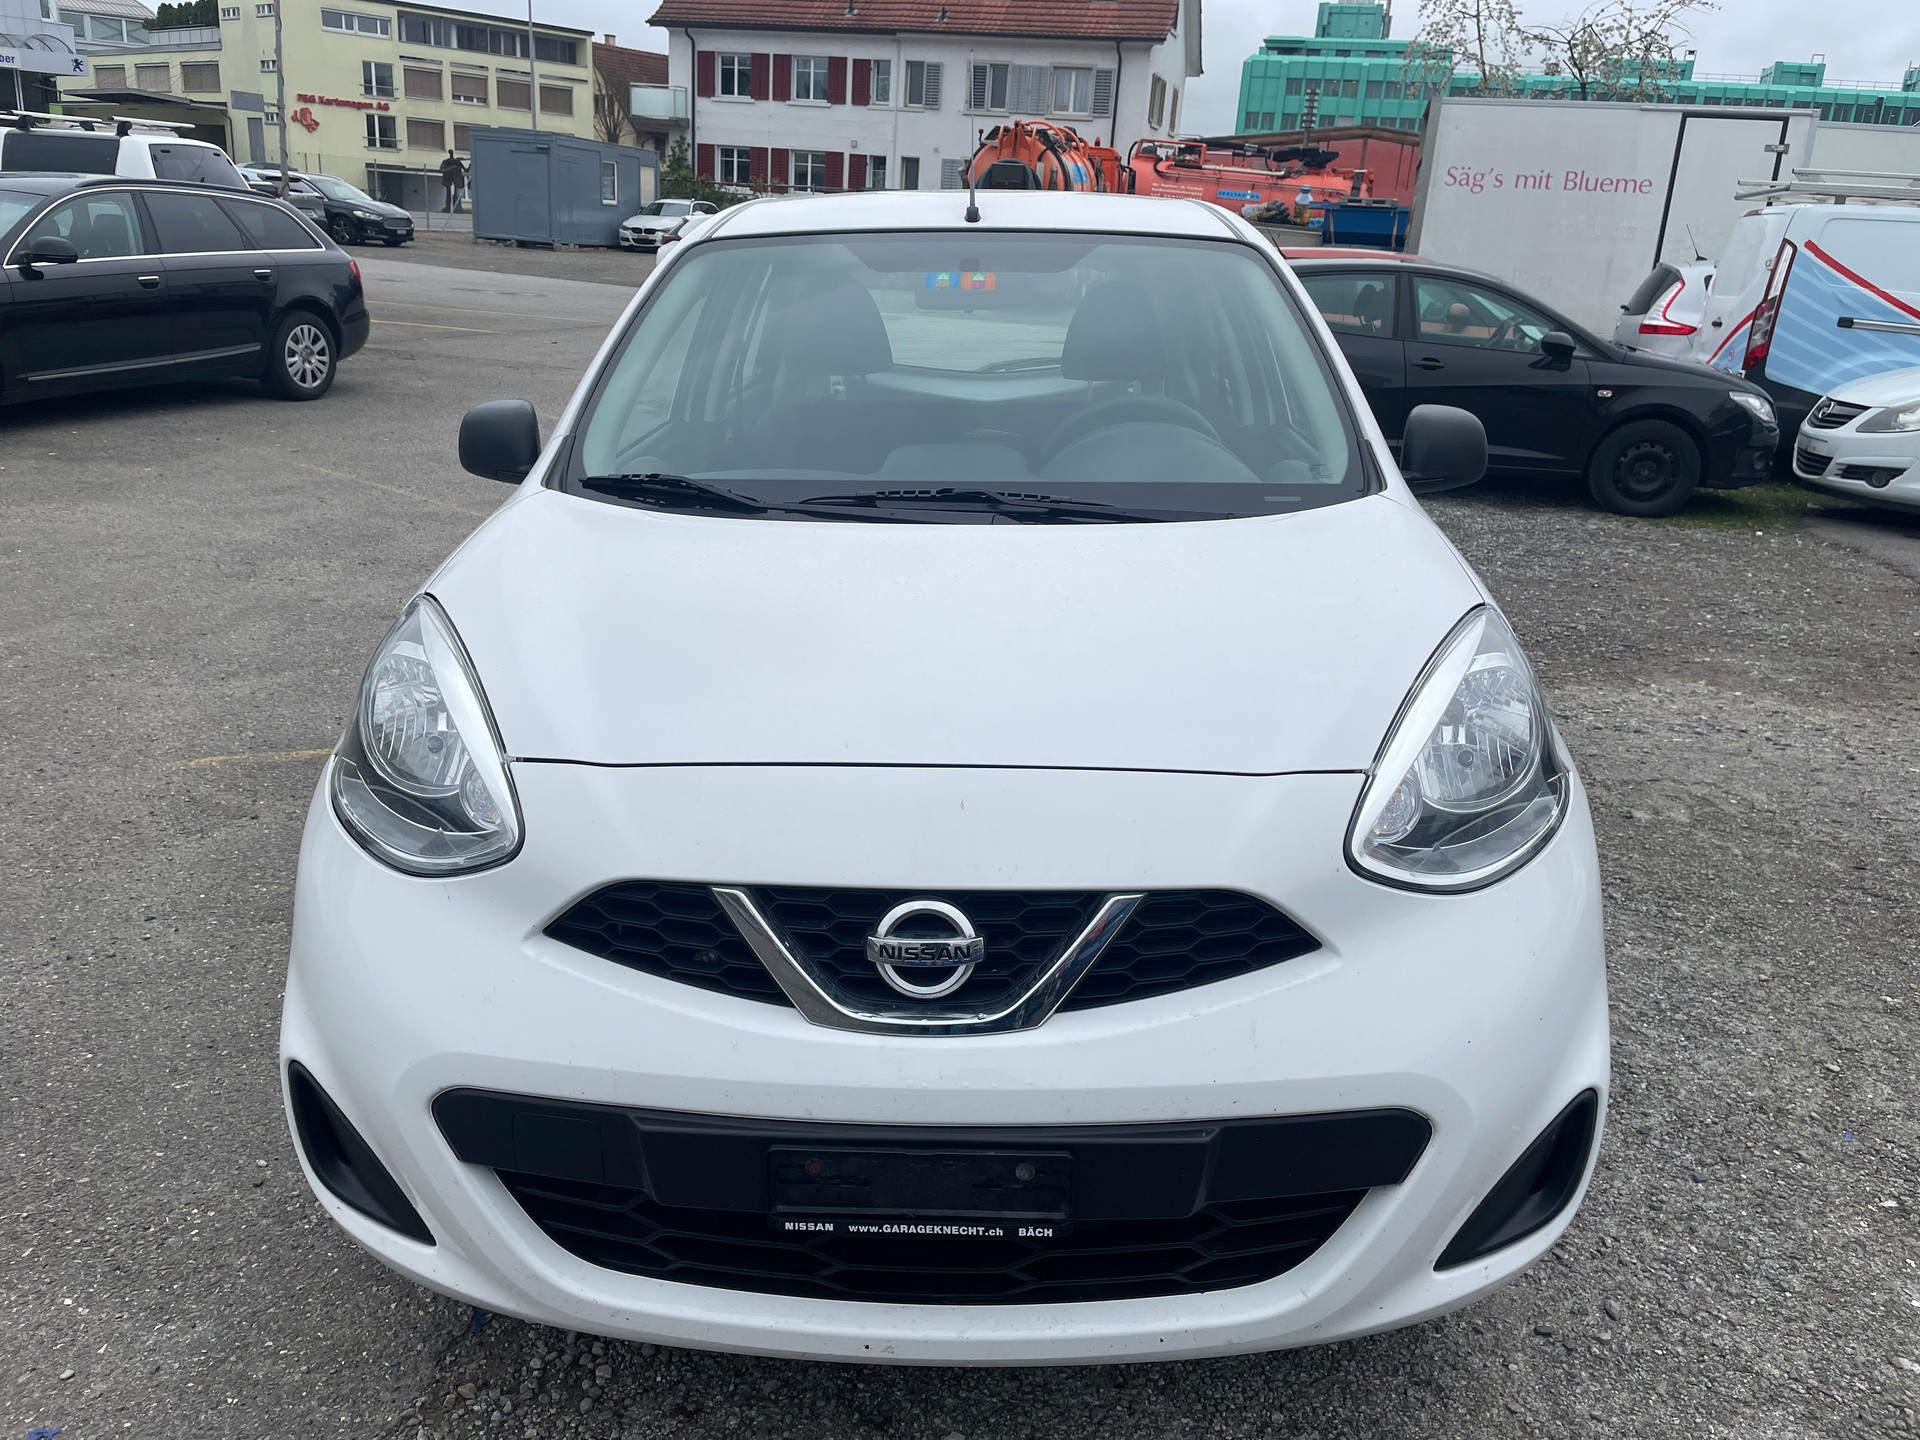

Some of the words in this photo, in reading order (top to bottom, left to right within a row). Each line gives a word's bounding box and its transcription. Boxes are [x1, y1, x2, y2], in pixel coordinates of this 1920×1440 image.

[376, 101, 390, 112] AG
[1514, 170, 1553, 190] mit
[1563, 170, 1653, 195] Blueme
[879, 944, 971, 961] NISSAN
[785, 1222, 834, 1231] NISSAN
[848, 1223, 1003, 1237] www.GARAGEKNECHT.ch
[1018, 1226, 1053, 1237] BÄCH
